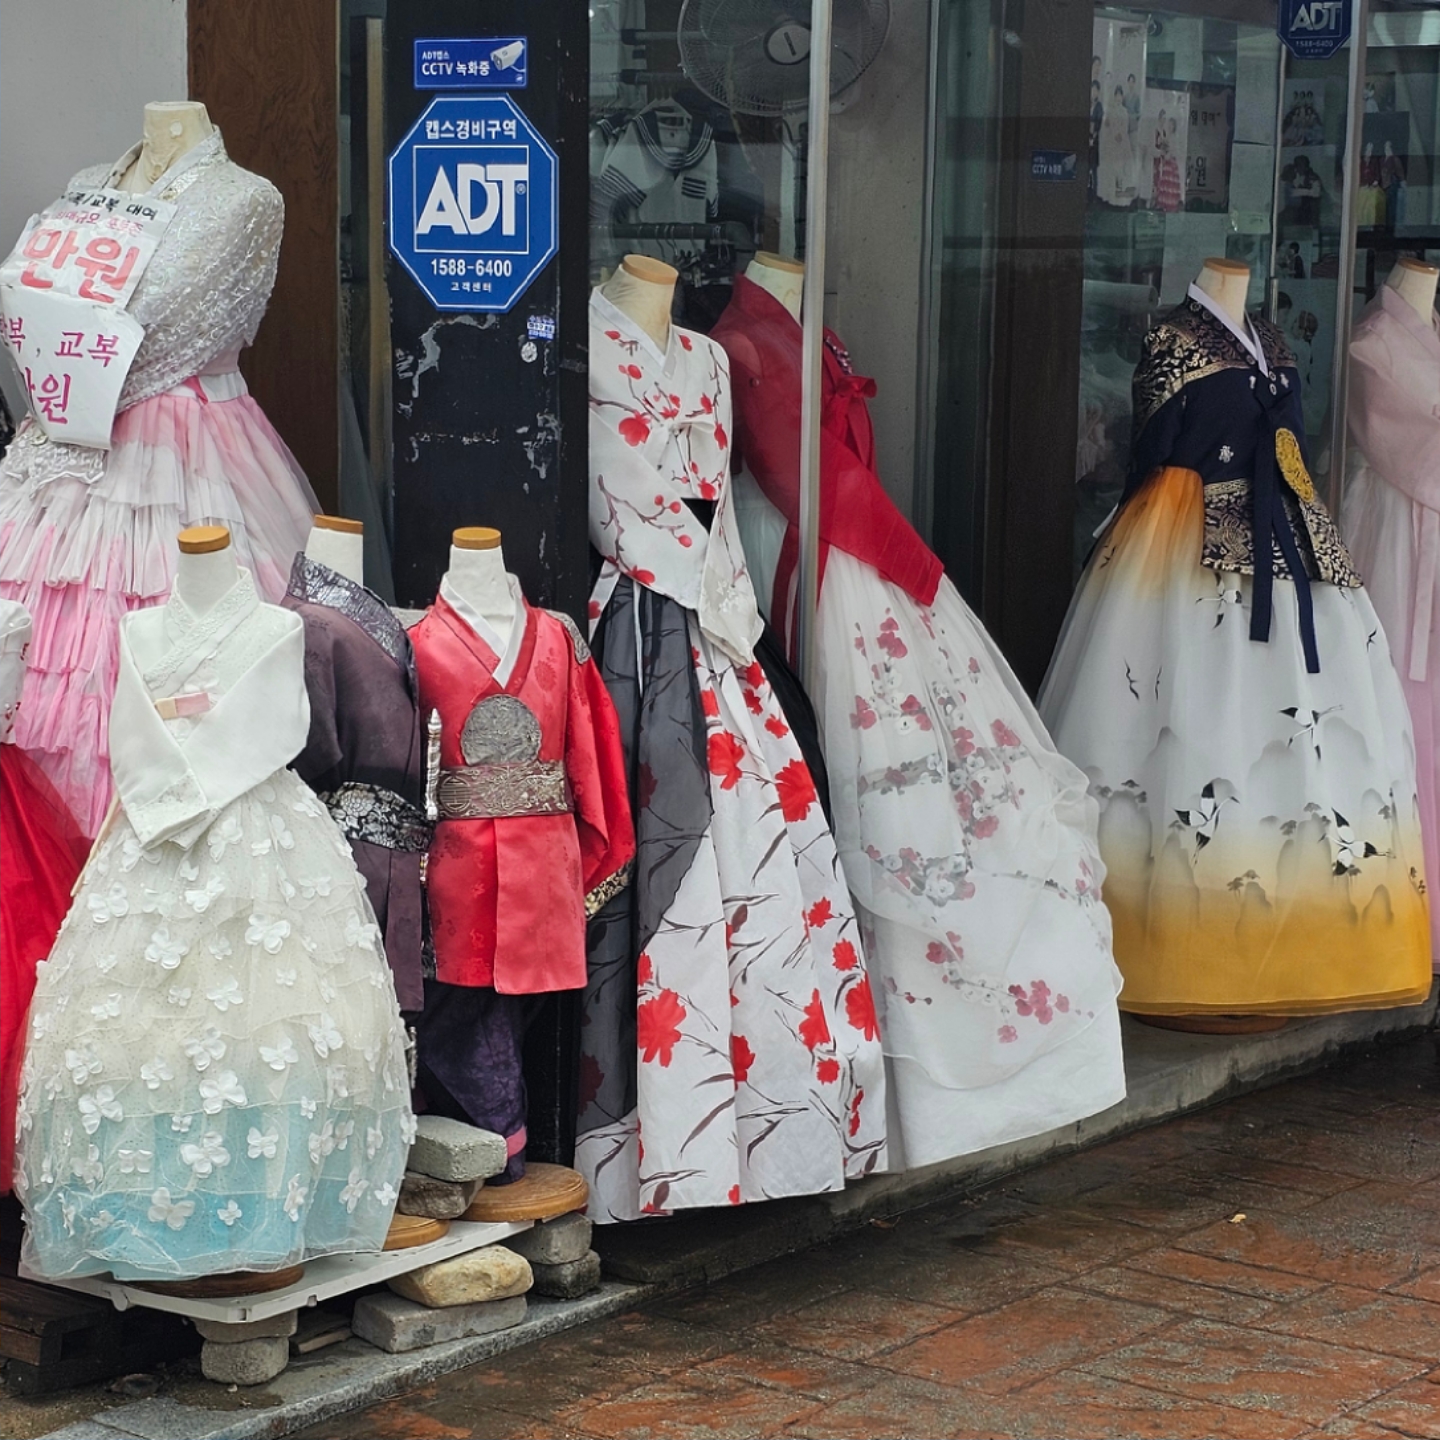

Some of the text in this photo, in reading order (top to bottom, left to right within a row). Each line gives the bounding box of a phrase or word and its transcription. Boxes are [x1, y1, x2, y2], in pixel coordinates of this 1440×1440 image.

[1290, 2, 1342, 31] ADT
[422, 51, 450, 60] ADT캡스
[422, 61, 490, 76] CCTV 녹화중
[425, 120, 517, 140] 캡스경비구역
[416, 163, 528, 236] ADT
[126, 203, 158, 221] 대여
[20, 228, 140, 304] 만원
[431, 258, 512, 277] 1588-6400
[54, 331, 120, 368] 교복
